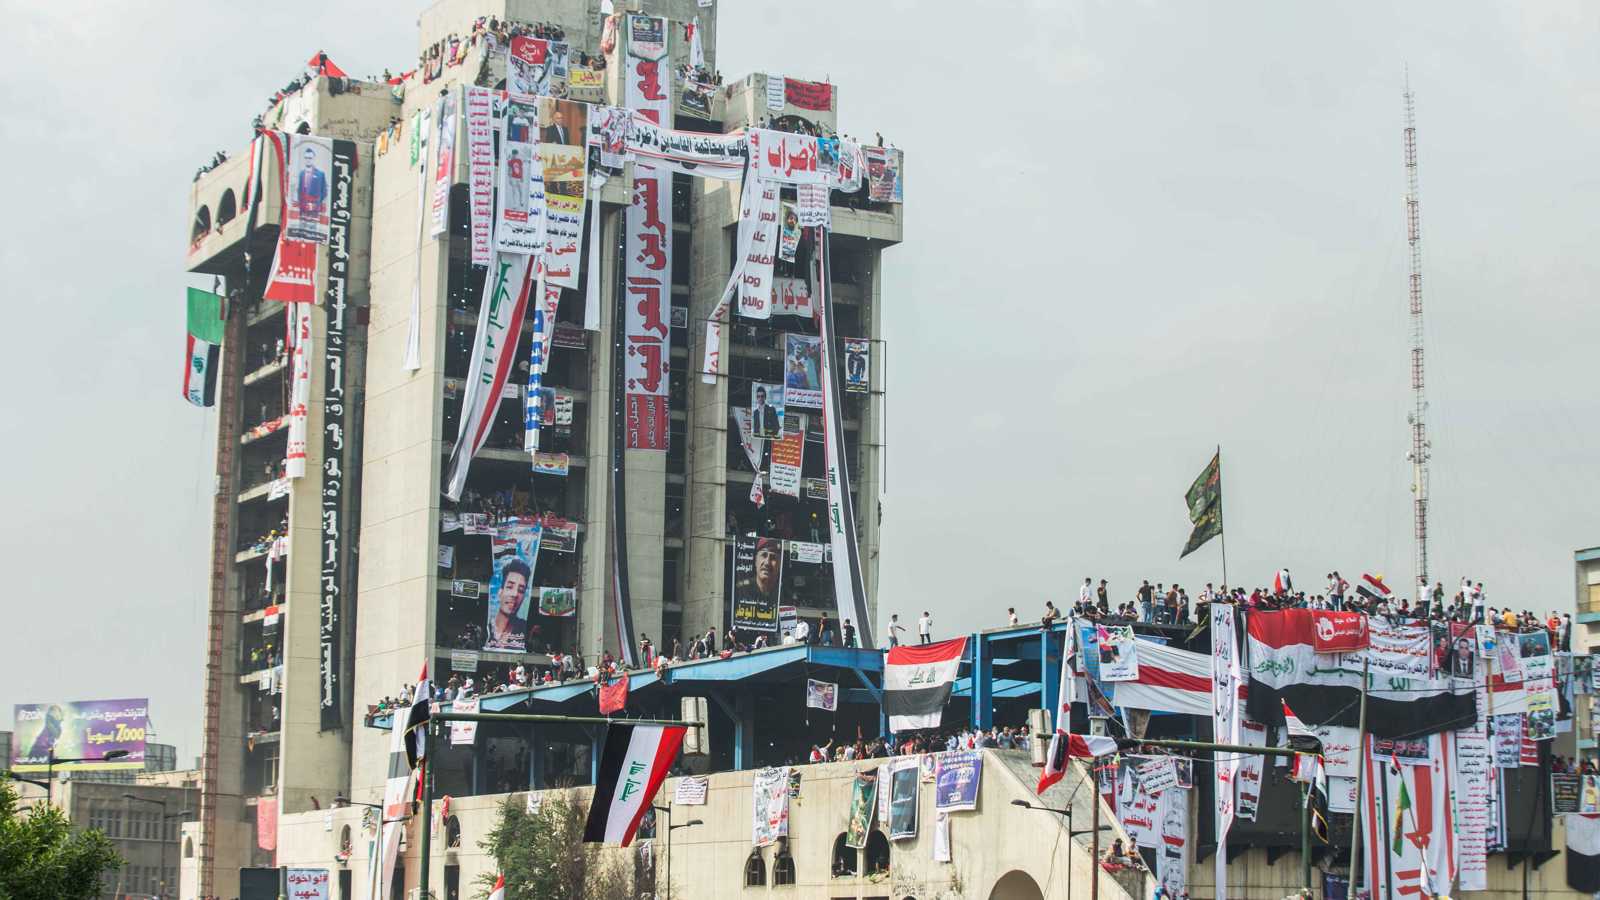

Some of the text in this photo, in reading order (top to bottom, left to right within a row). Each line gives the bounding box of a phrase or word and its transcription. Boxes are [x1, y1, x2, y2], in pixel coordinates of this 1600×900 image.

[332, 154, 352, 209] الرحمة
[767, 137, 817, 177] لاضراب
[331, 210, 350, 272] والخلود
[327, 277, 347, 343] لشهداء
[628, 277, 668, 393] العراقية
[325, 347, 345, 416] العراق
[323, 456, 342, 496] ثورة
[322, 501, 341, 569] اكتوبر
[321, 569, 339, 630] الوطنية
[1389, 676, 1410, 690] الله
[294, 887, 320, 900] شهيد
